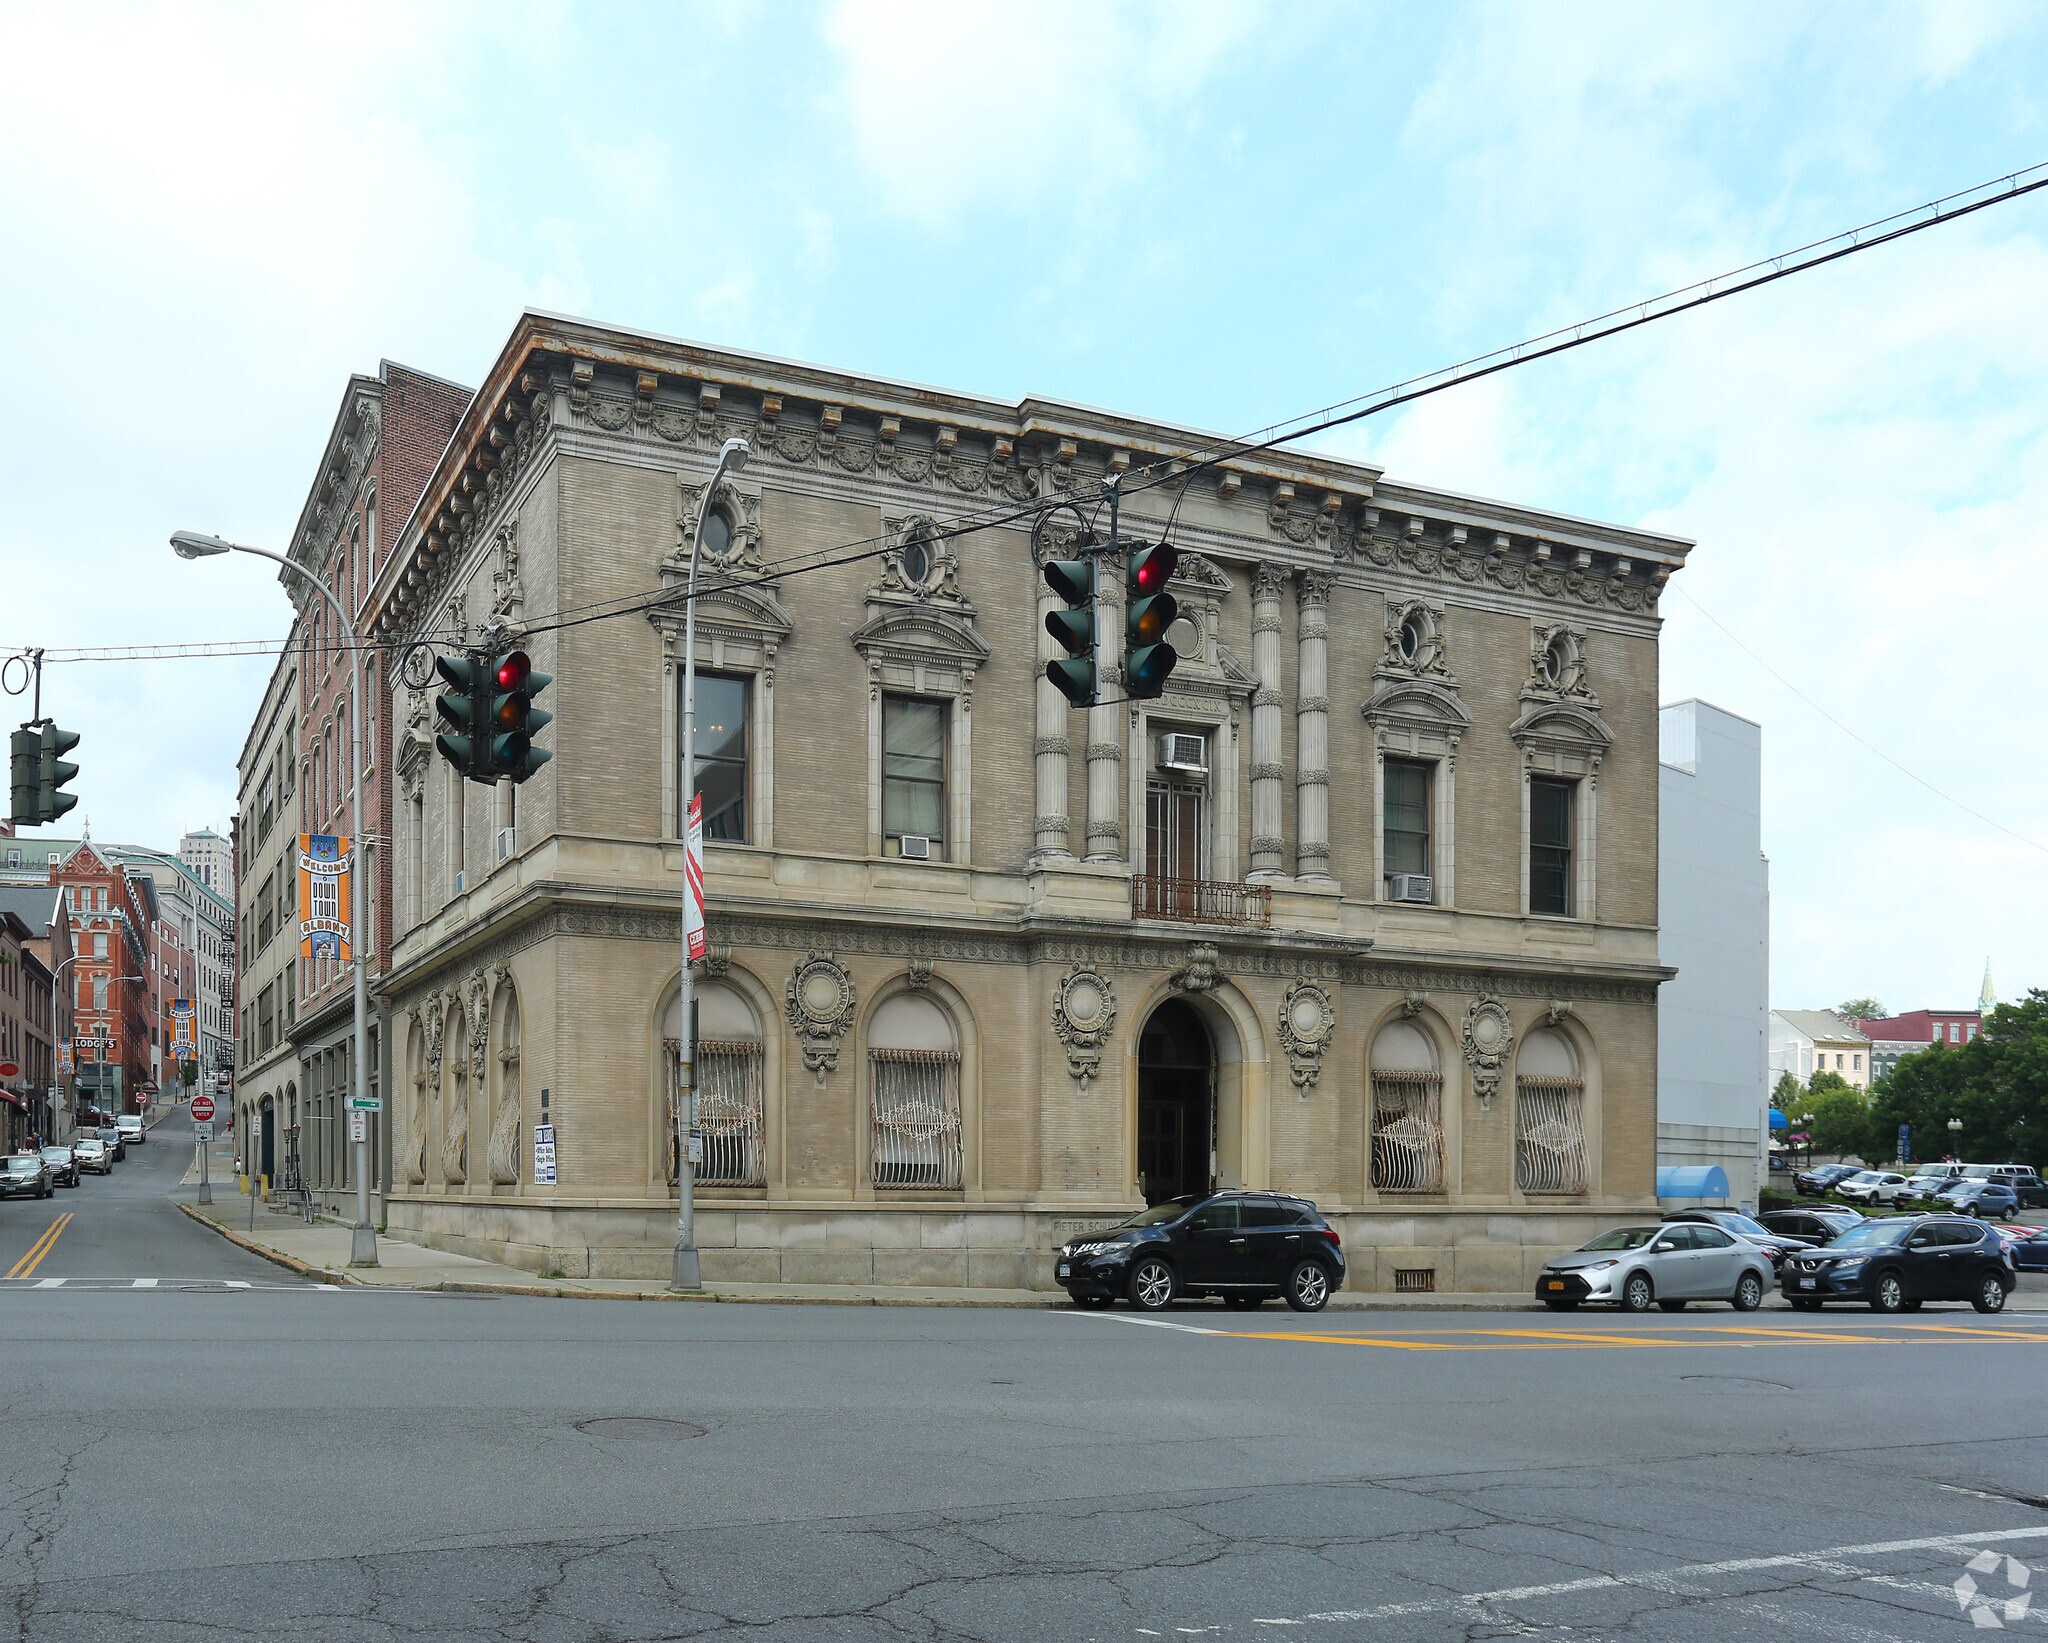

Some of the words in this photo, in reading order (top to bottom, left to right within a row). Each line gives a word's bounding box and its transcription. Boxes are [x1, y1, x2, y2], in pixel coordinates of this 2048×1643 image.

[302, 858, 347, 873] WELCOME
[313, 882, 336, 899] DOWN
[313, 900, 336, 917] TOWN
[303, 919, 347, 936] ALBANY
[75, 1039, 115, 1048] LODGE'S
[1053, 1221, 1084, 1232] PIETER
